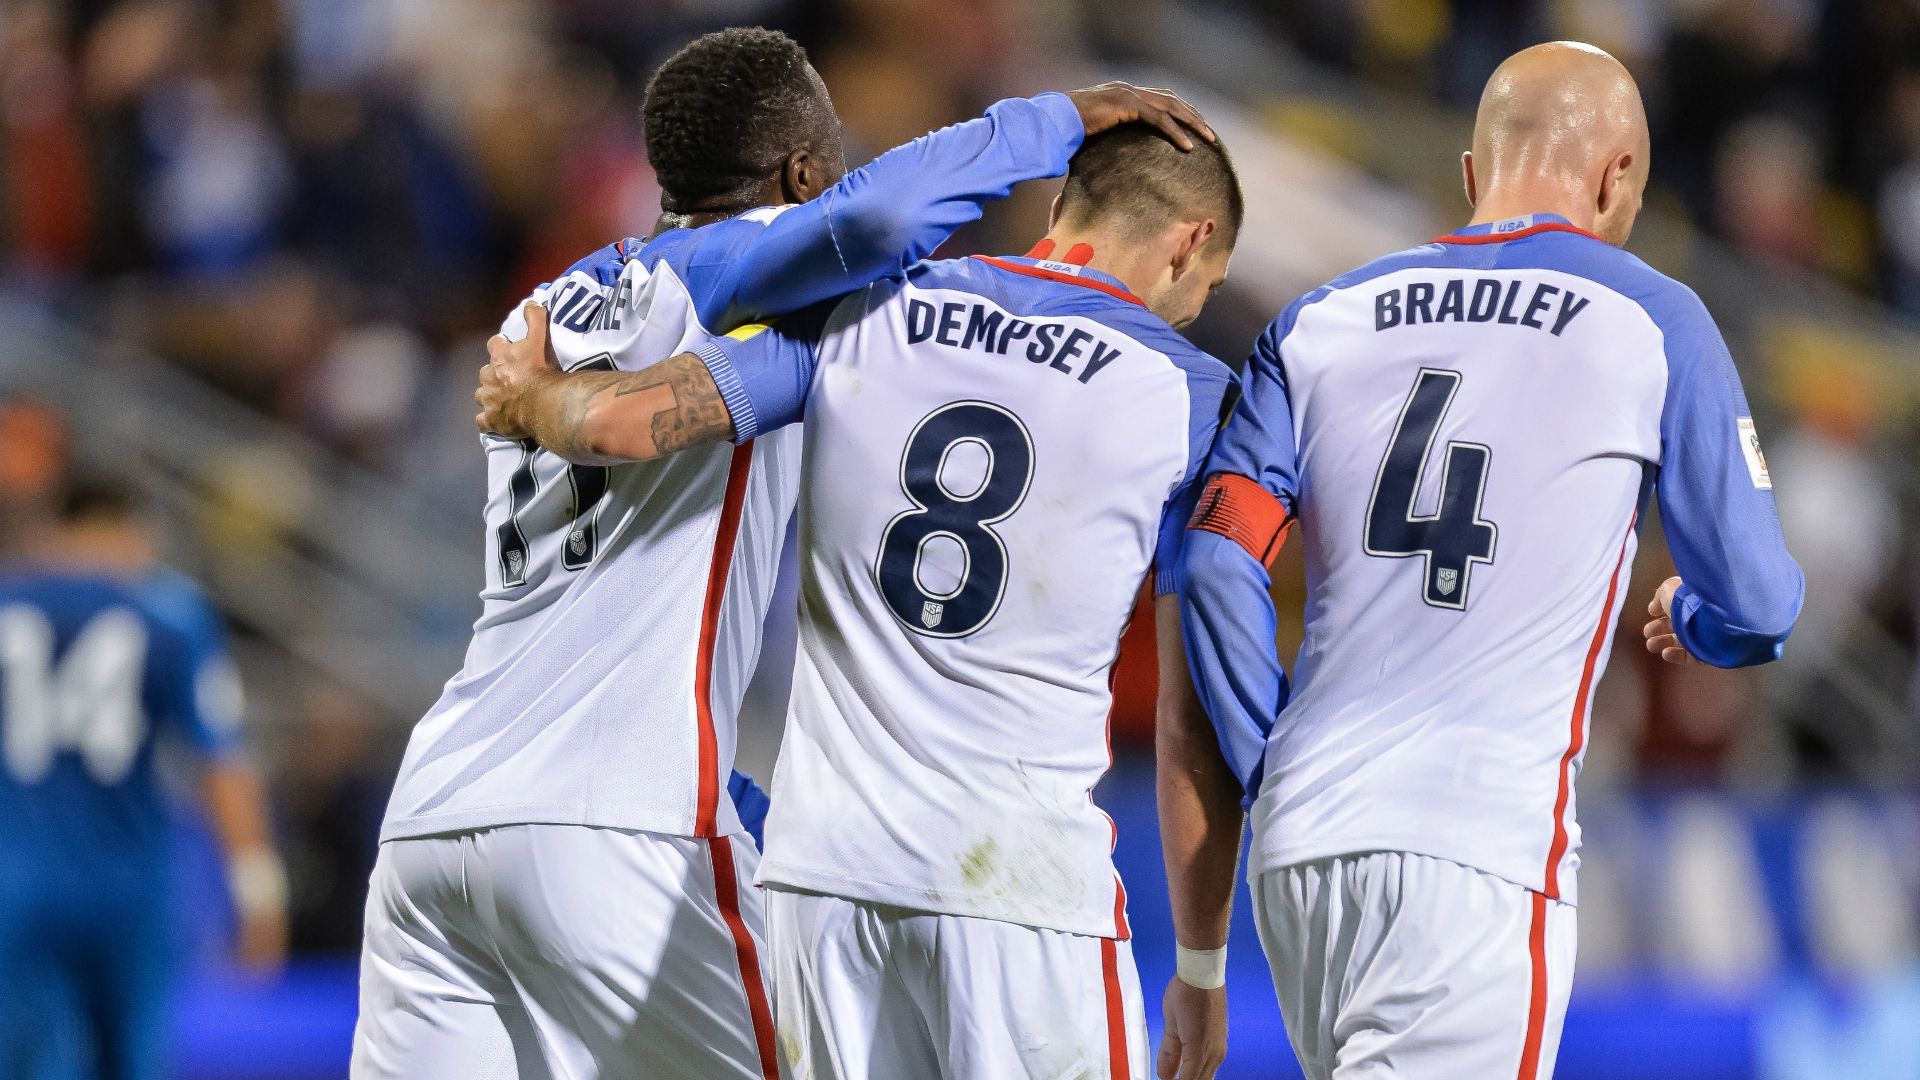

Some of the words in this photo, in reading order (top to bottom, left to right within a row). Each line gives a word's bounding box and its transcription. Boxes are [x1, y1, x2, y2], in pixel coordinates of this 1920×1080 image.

[1043, 262, 1072, 273] USA
[1498, 220, 1526, 233] USA
[907, 298, 1122, 385] DEMPSEY
[1375, 279, 1591, 337] BRADLEY
[874, 399, 1036, 640] 8
[1363, 367, 1498, 611] 4
[0, 600, 150, 787] 14
